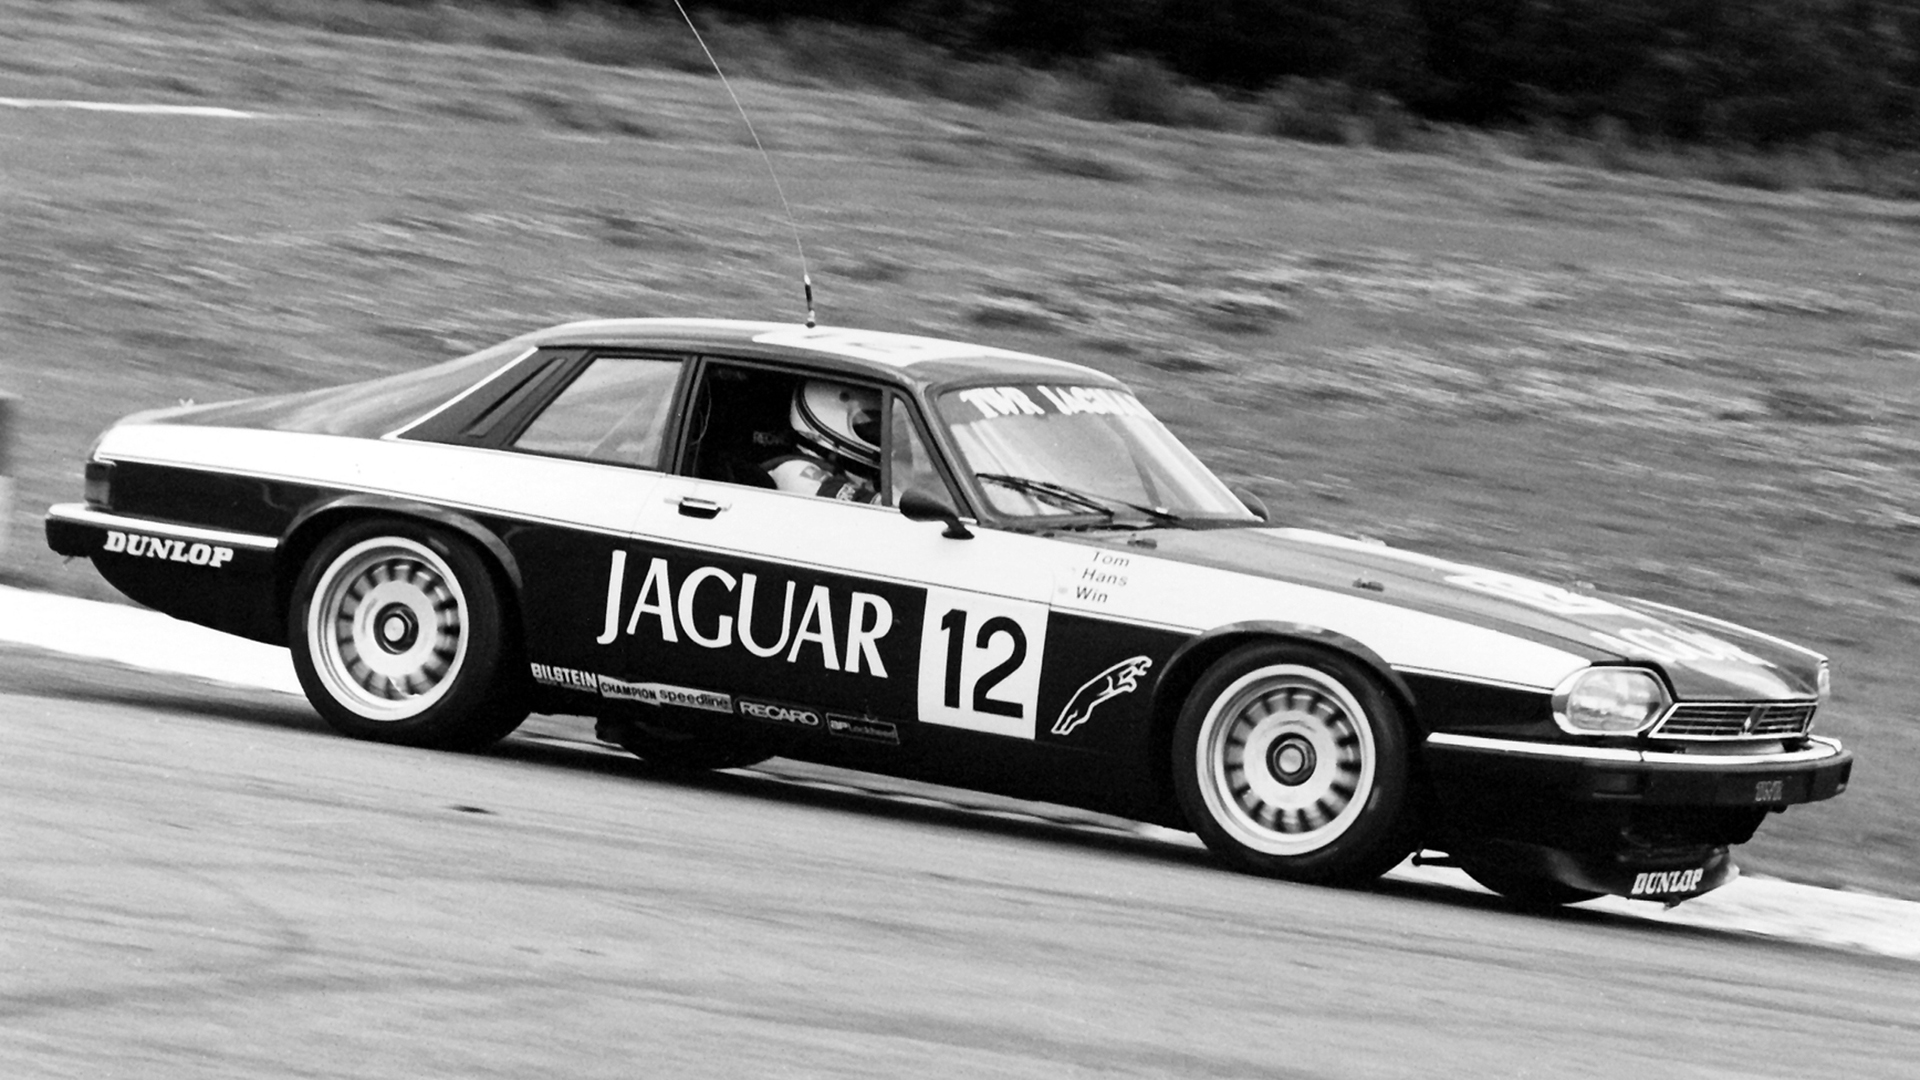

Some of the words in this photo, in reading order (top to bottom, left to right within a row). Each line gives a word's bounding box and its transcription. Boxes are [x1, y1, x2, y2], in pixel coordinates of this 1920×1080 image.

[103, 530, 234, 568] DUNLOP
[1092, 551, 1130, 568] Tom
[1082, 567, 1128, 587] Hans
[1076, 585, 1108, 604] Win
[596, 549, 894, 679] JAGUAR
[530, 662, 598, 689] BILSTEIN
[941, 608, 1028, 719] 12
[601, 681, 657, 701] CHAMPION
[658, 689, 730, 710] speedline
[739, 701, 819, 726] RECARO
[1631, 868, 1704, 896] DUNLOP
